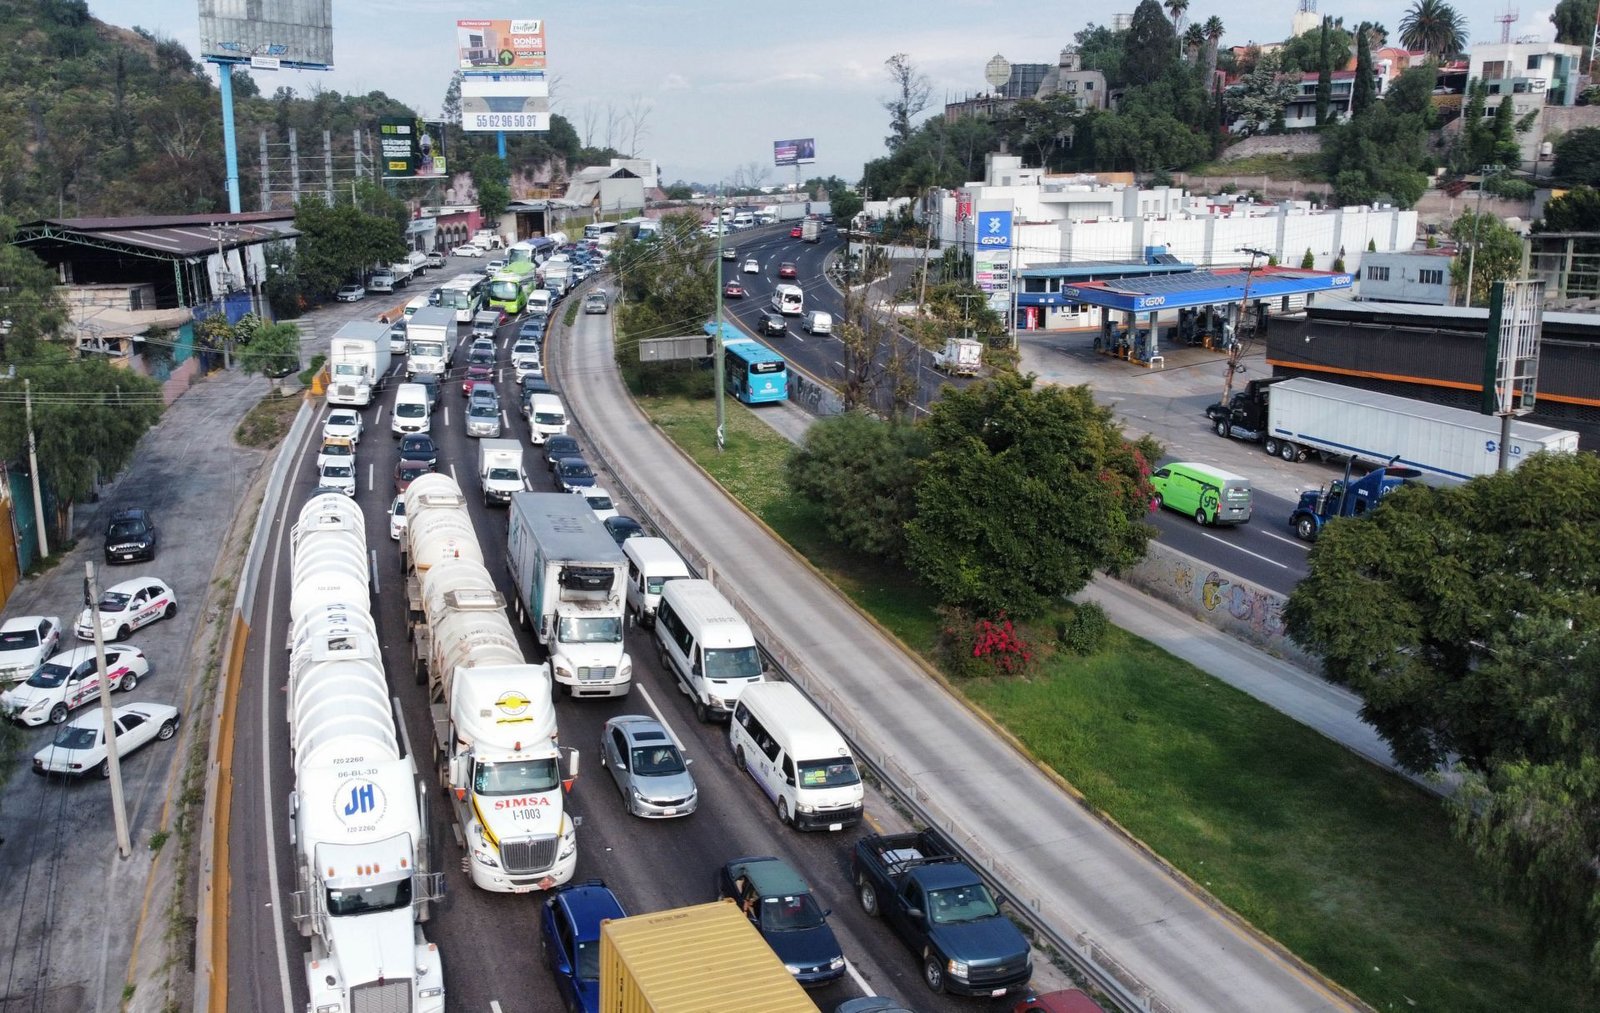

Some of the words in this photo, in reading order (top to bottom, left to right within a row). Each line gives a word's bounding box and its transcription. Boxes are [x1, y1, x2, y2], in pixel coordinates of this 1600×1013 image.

[476, 115, 488, 127] 55
[489, 115, 500, 127] 62
[501, 115, 512, 127] 96
[514, 115, 525, 127] 50
[526, 115, 537, 127] 37
[345, 756, 364, 764] 2260
[344, 783, 375, 816] JH
[494, 797, 550, 810] SIMSA
[512, 808, 541, 821] I-1003
